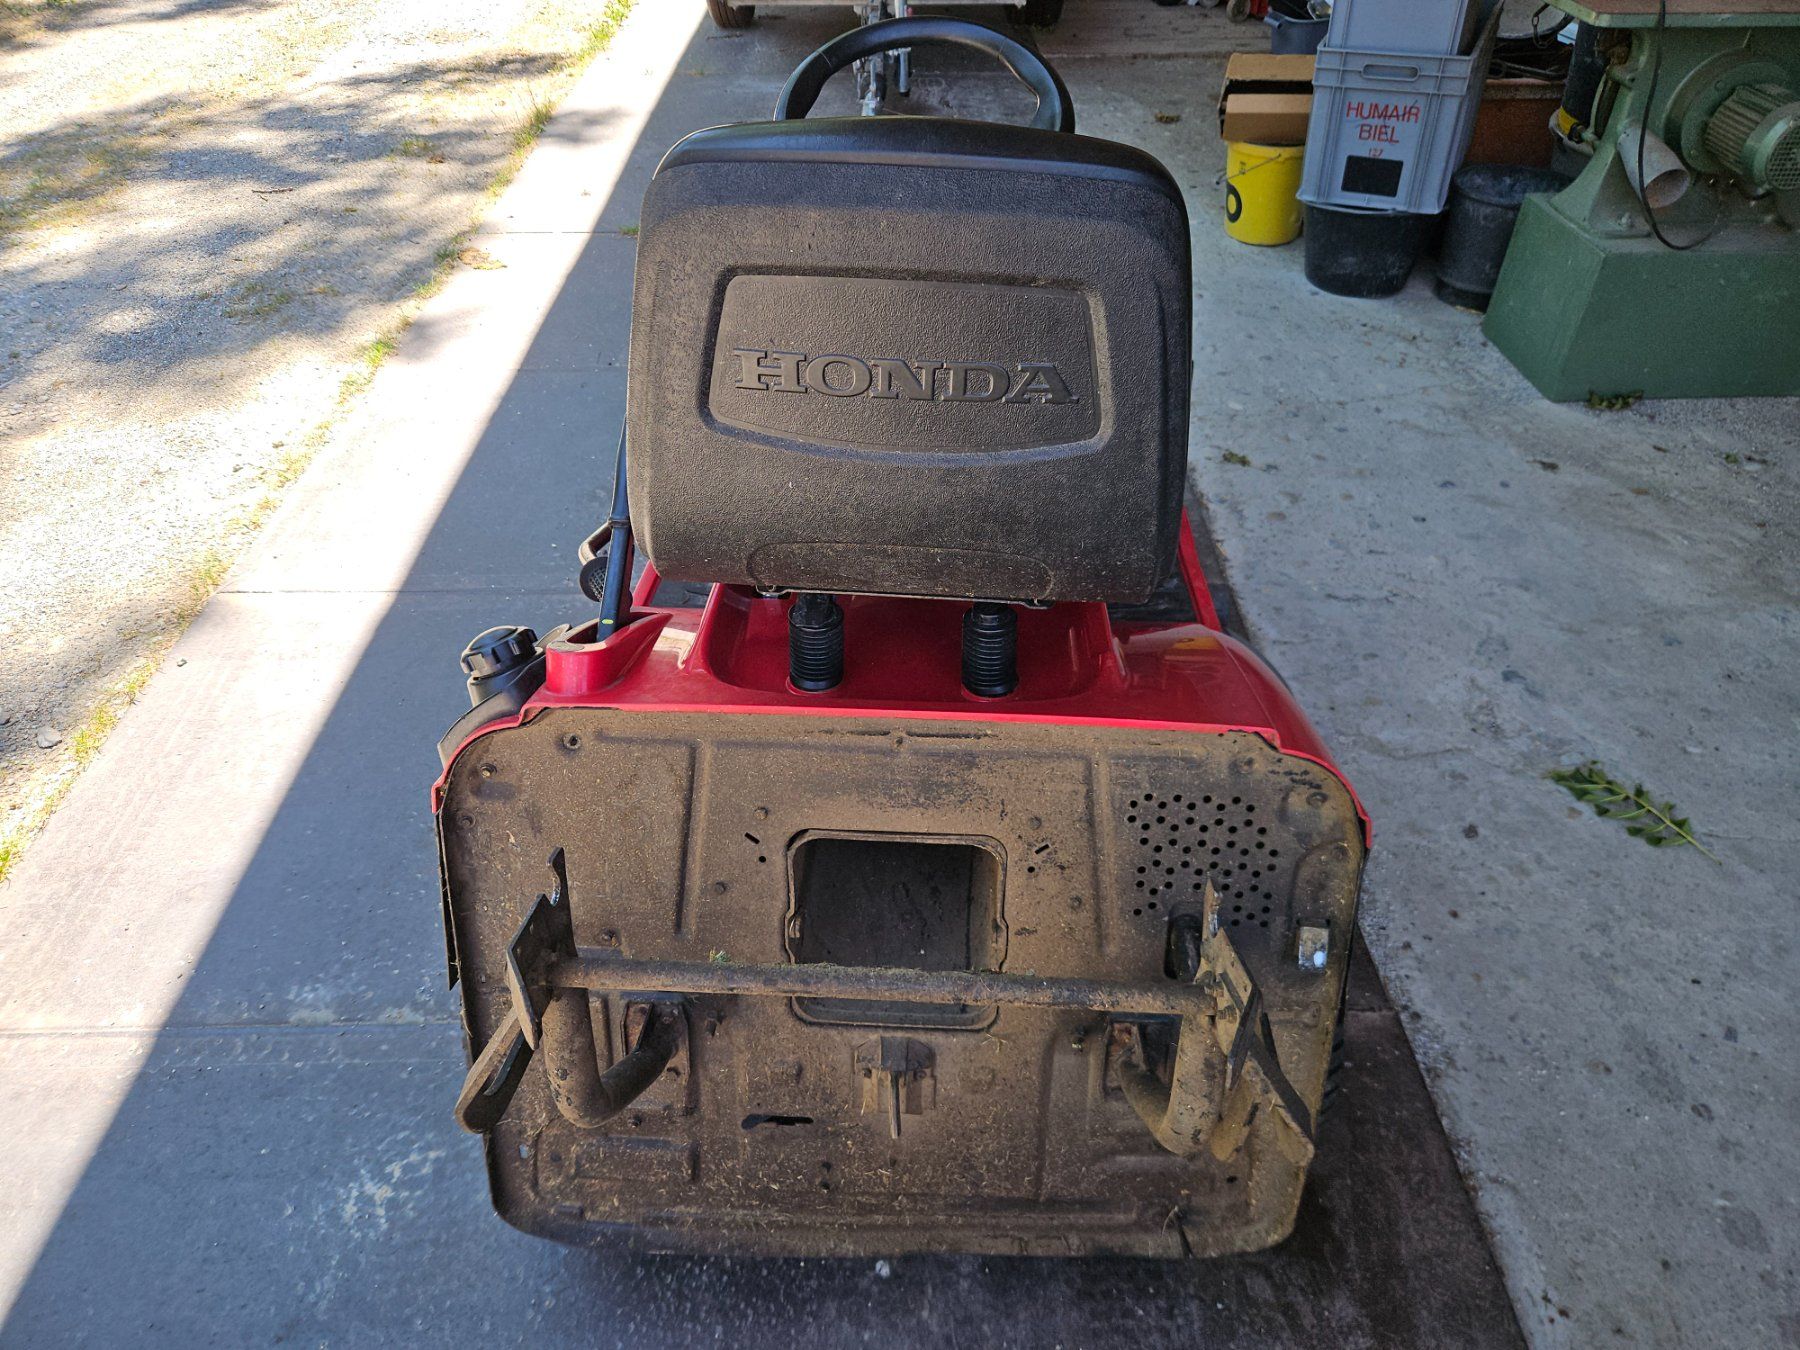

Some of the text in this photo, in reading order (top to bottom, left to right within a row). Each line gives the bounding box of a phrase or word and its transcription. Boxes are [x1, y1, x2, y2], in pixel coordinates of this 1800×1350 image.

[1346, 101, 1420, 124] HUMAIR
[1359, 123, 1400, 144] BIEL
[733, 348, 1080, 404] HONDA
